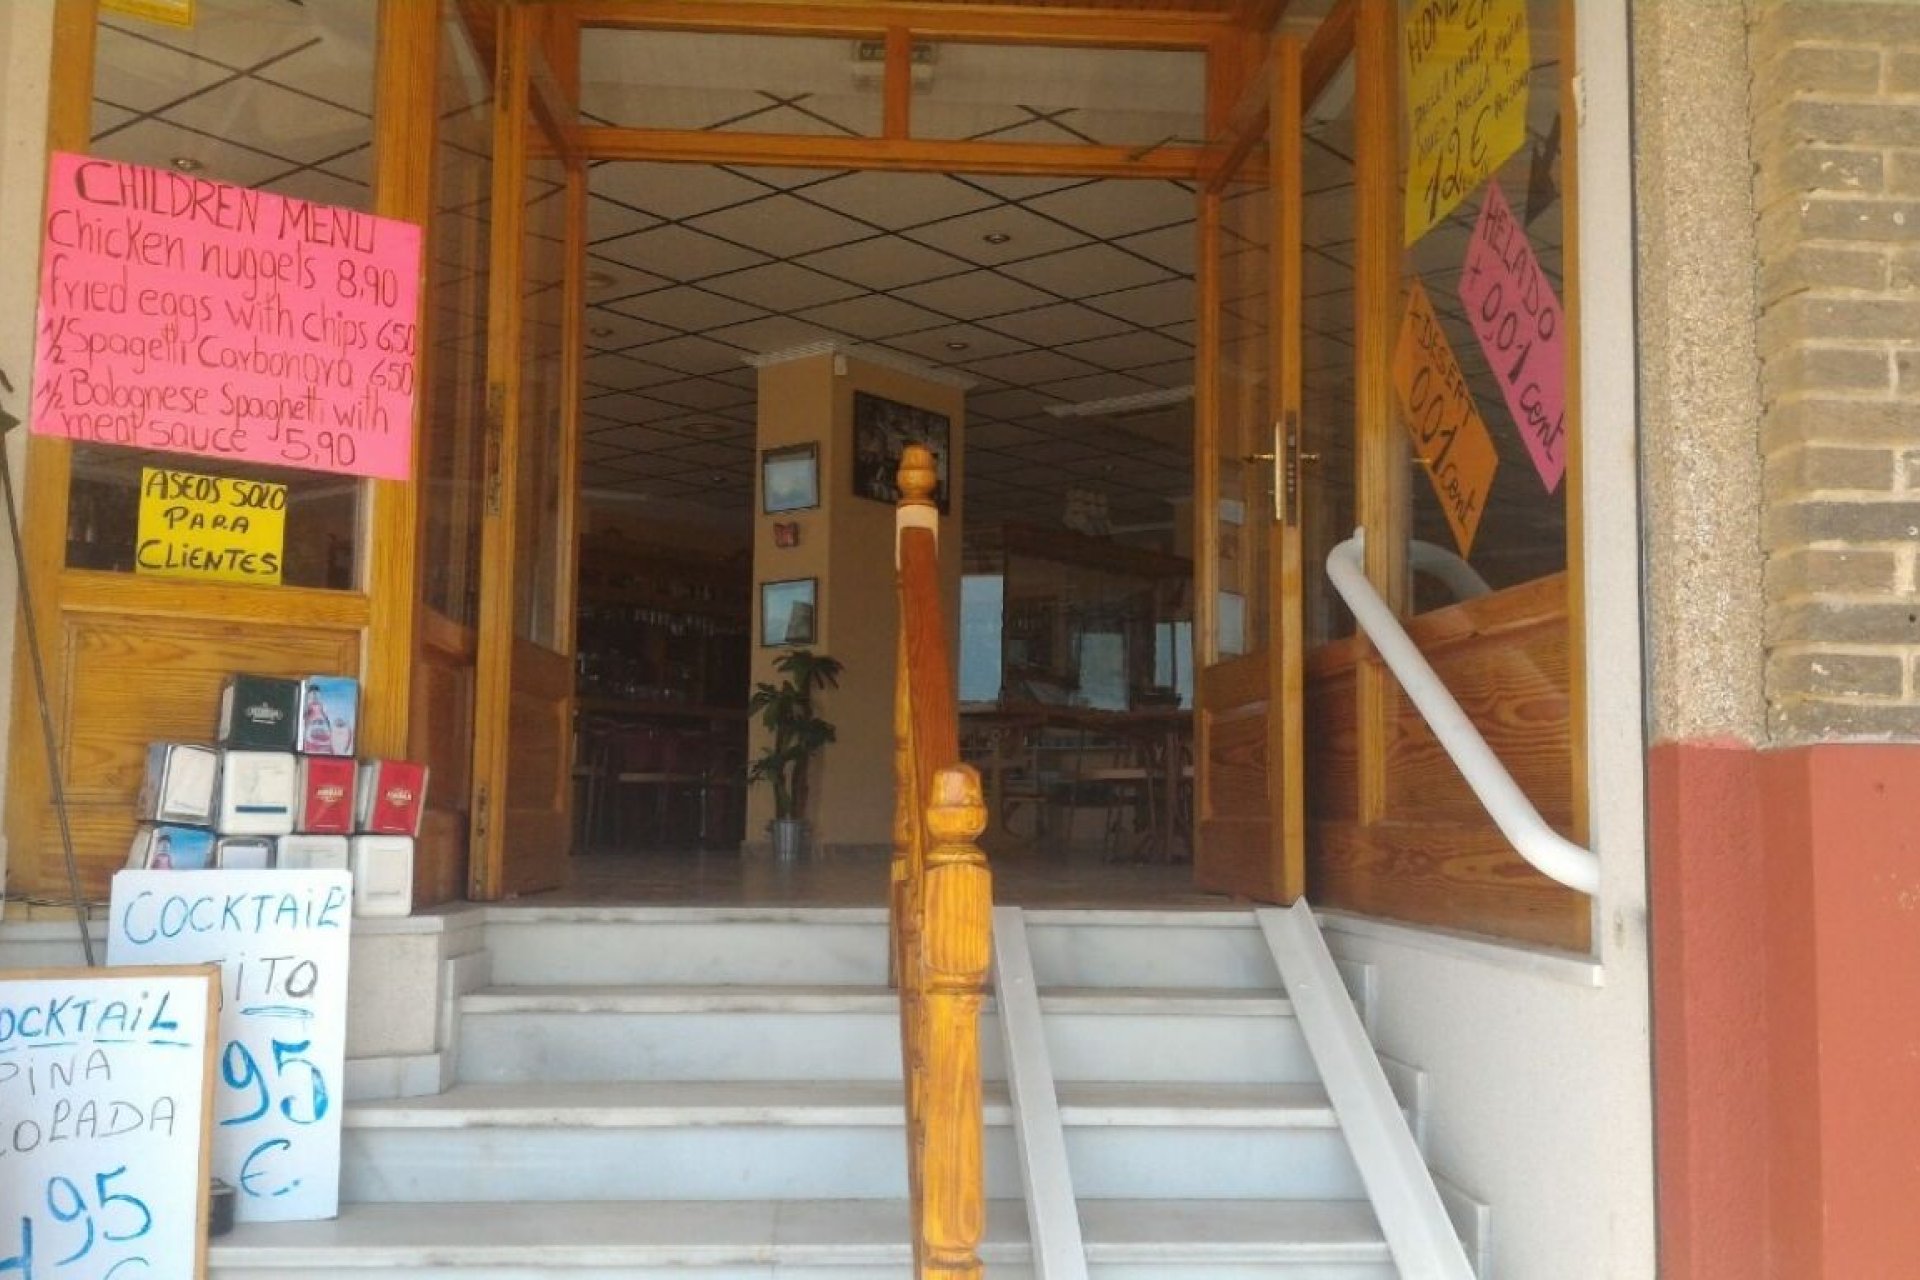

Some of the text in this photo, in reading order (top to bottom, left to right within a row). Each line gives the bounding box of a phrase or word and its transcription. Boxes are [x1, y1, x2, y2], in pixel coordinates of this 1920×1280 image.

[75, 161, 377, 255] CHILDREN MENU
[48, 208, 184, 271] Chicken
[1482, 193, 1556, 342] HELADO
[138, 288, 213, 345] eggs
[225, 292, 294, 341] with
[69, 363, 208, 431] Bolognese
[333, 384, 389, 435] with
[62, 410, 356, 466] meat sauce 5,90
[145, 470, 286, 511] ASEOS SOLO
[163, 505, 250, 534] PARA
